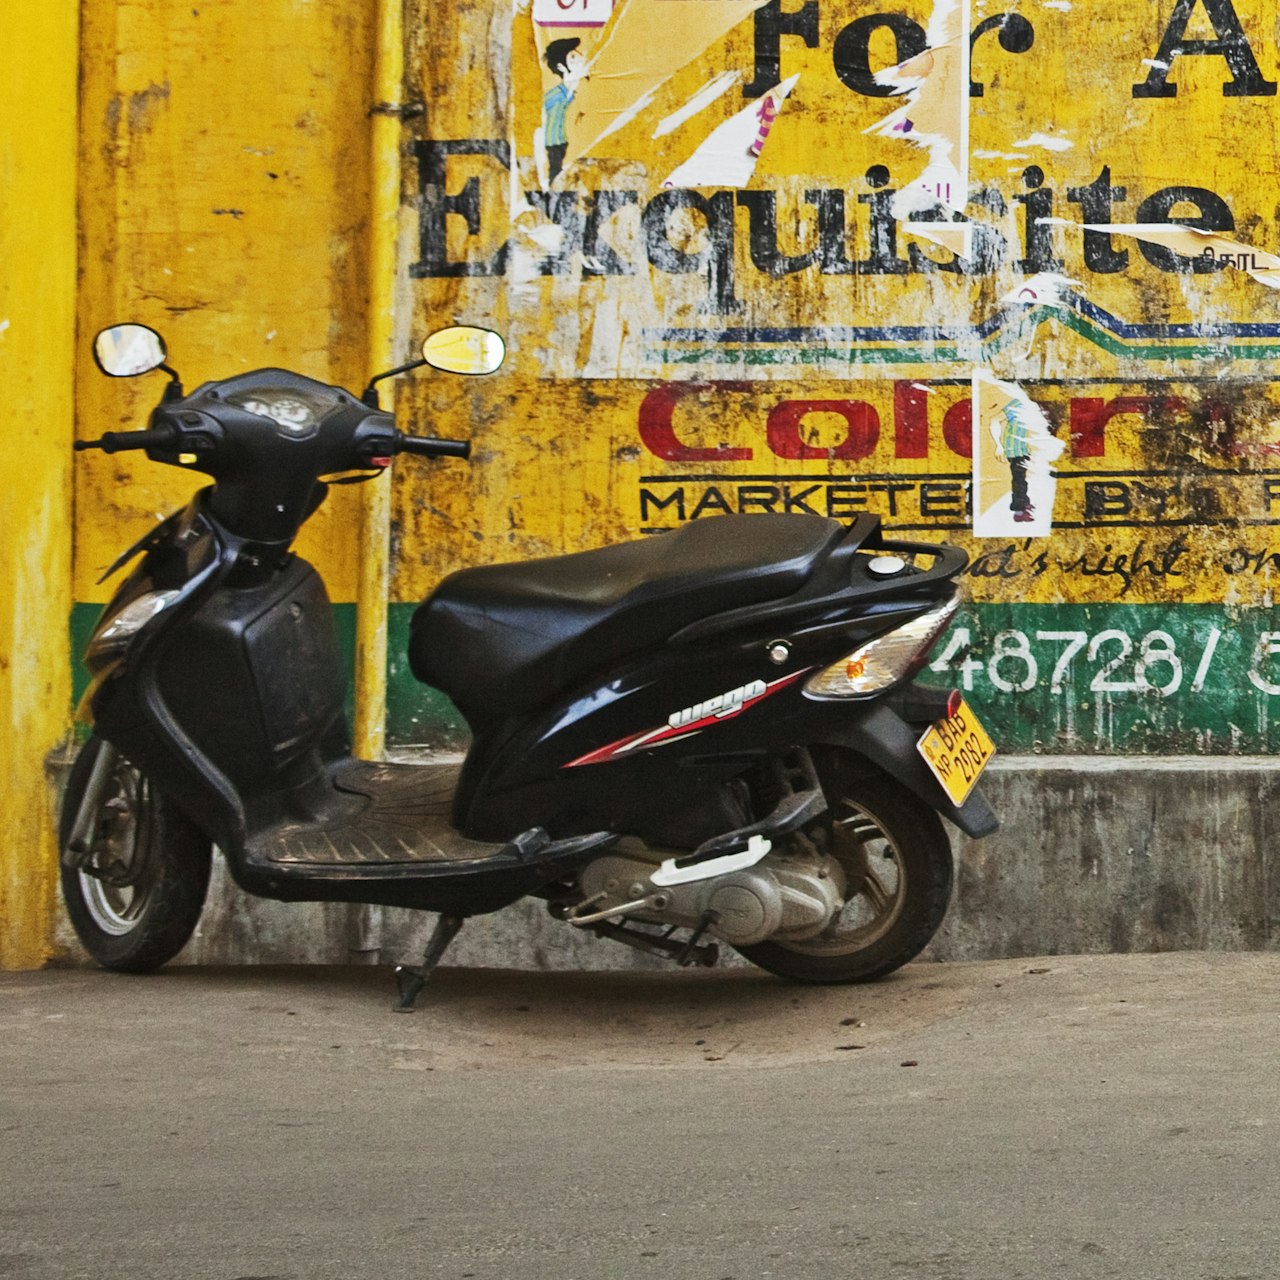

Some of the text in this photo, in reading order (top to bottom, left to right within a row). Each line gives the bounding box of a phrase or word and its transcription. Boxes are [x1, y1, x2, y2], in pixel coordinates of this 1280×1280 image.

[640, 484, 974, 521] MARKETE
[1086, 480, 1180, 517] BY
[1055, 538, 1190, 597] right
[668, 680, 767, 728] wego
[935, 754, 953, 781] NP
[954, 732, 987, 783] 2982
